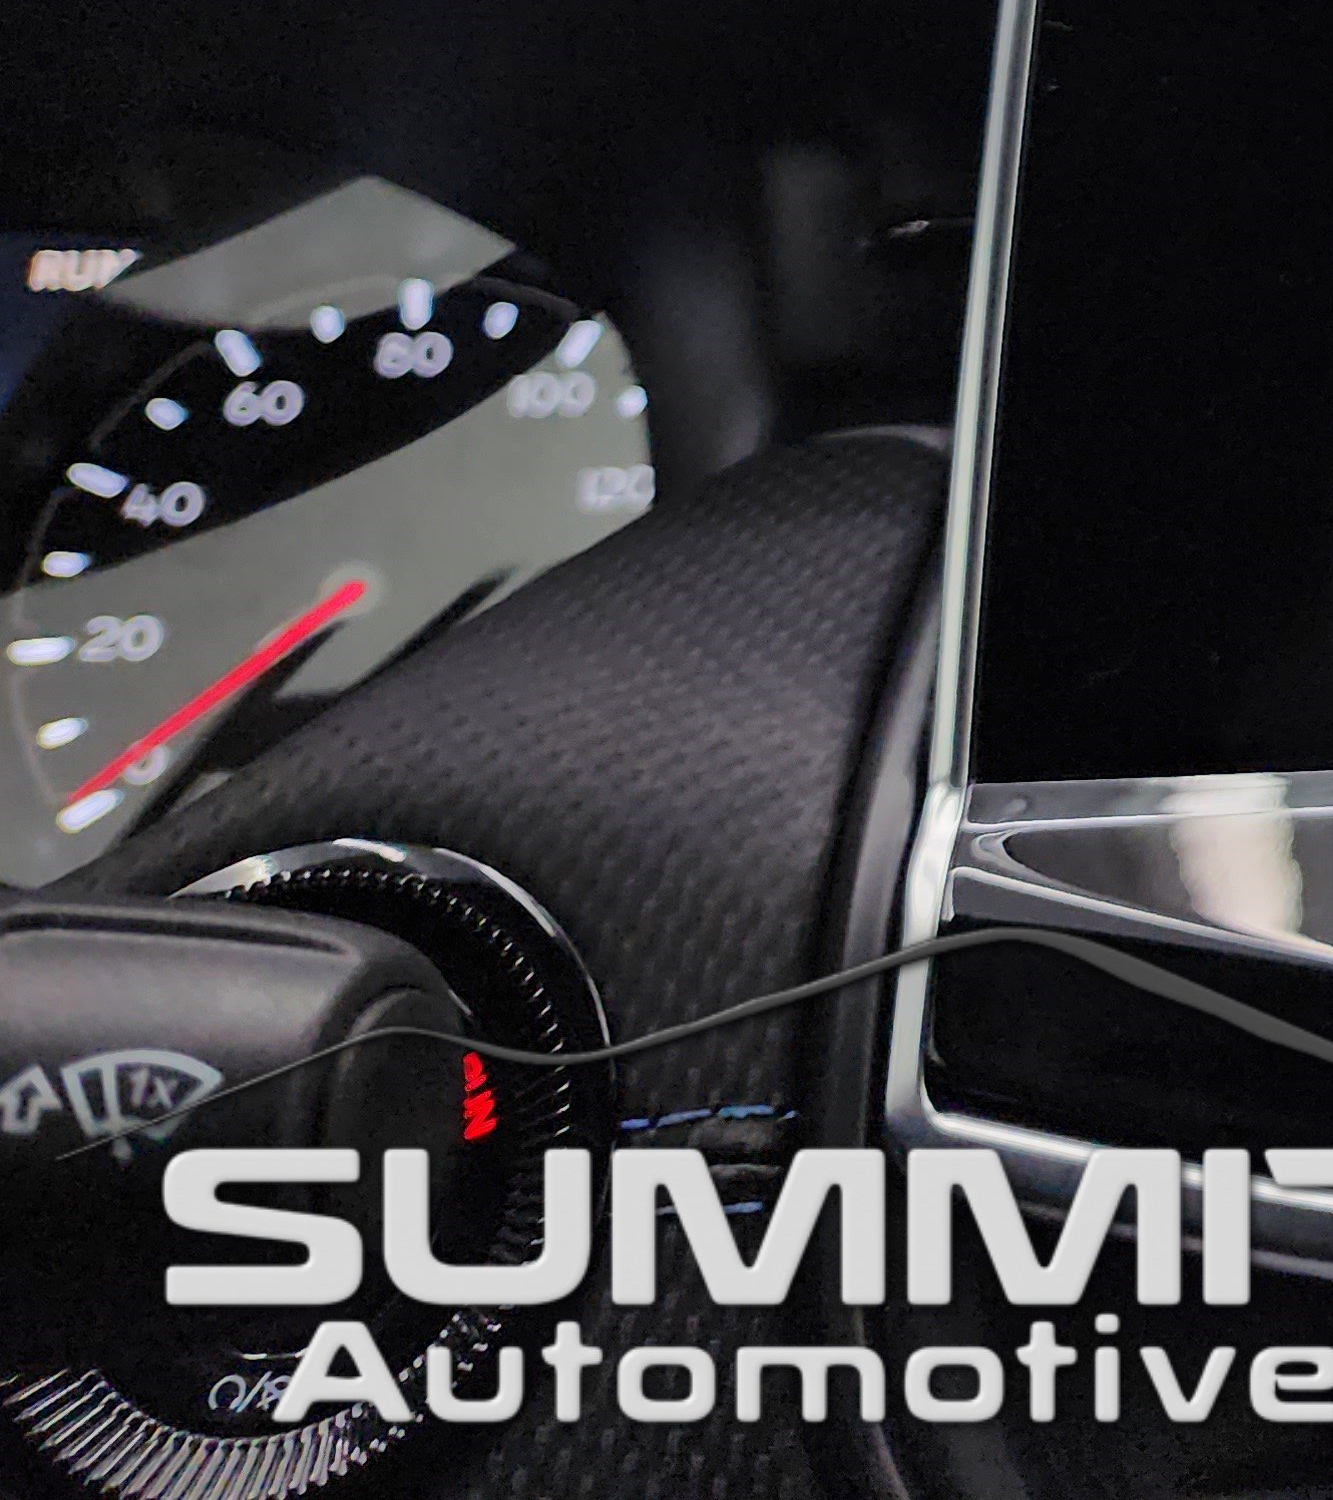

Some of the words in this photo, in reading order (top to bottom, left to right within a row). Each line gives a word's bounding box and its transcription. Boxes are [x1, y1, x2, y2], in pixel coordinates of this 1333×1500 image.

[223, 380, 305, 426] 60
[121, 481, 206, 527] 40
[80, 614, 164, 662] 20
